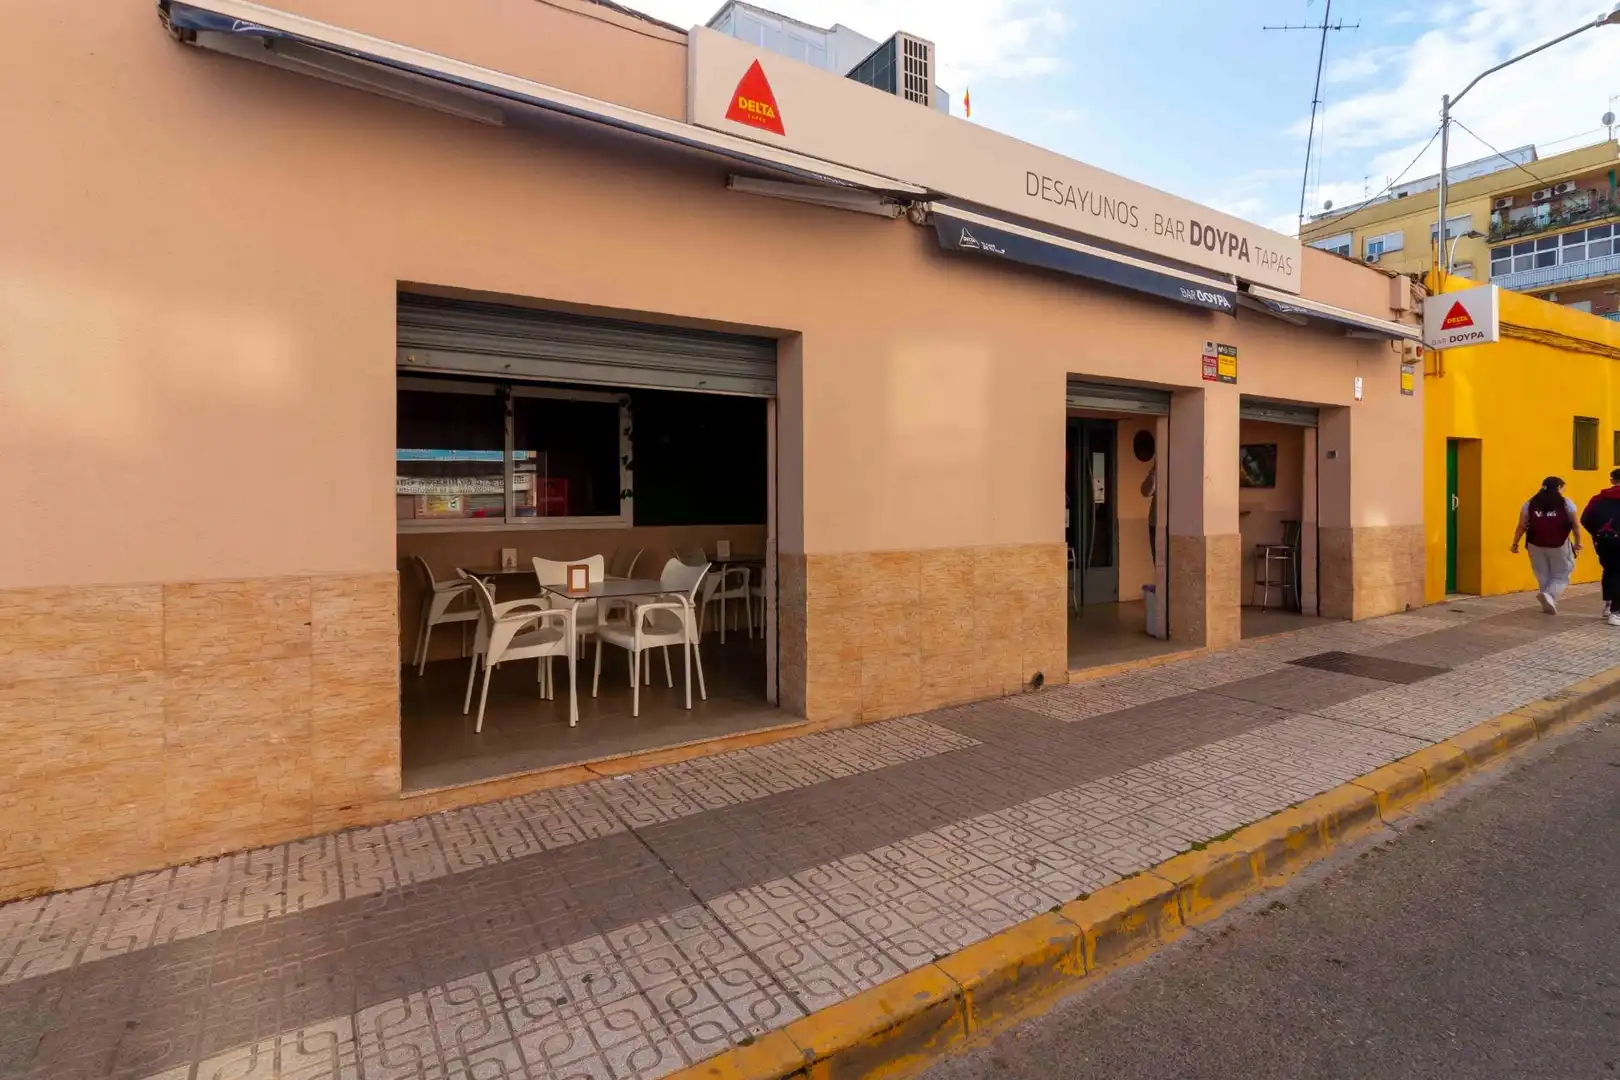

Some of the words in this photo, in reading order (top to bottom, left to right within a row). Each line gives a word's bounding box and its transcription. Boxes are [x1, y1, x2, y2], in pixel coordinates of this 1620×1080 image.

[738, 96, 775, 118] DELTA
[1026, 171, 1139, 228] DESAYUNOS
[1154, 213, 1185, 242] BAR
[1190, 219, 1250, 263] DOYPA
[1255, 246, 1293, 277] TAPAS
[1179, 287, 1196, 301] BAR
[1196, 289, 1231, 309] DOYPA
[1447, 315, 1468, 324] DELTA
[1449, 331, 1484, 343] DOYPA
